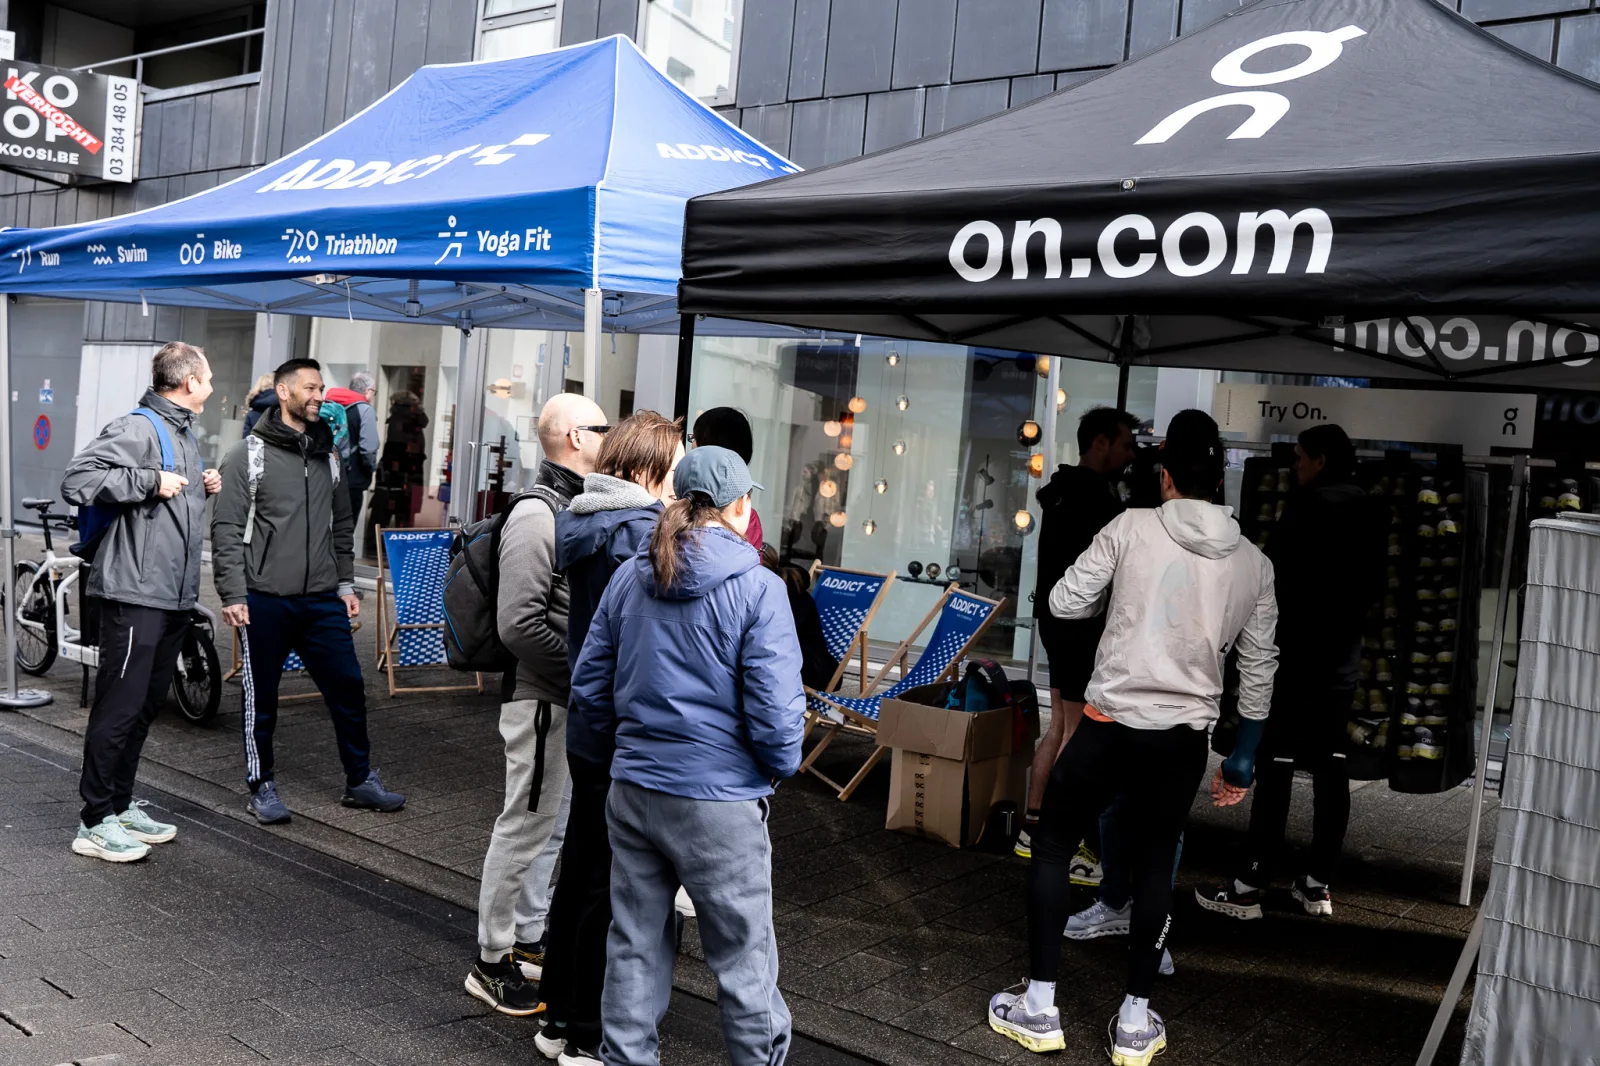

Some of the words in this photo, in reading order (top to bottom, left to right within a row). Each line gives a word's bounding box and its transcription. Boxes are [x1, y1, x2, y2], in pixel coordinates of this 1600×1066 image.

[114, 83, 128, 101] 05
[11, 79, 97, 147] VERKOCHT
[113, 105, 127, 122] 48
[111, 127, 126, 153] 284
[109, 158, 123, 175] 03
[656, 142, 774, 170] ADDICT
[256, 143, 482, 193] ADDICT
[117, 243, 148, 263] Swim
[213, 239, 242, 260] Bike
[325, 233, 398, 257] Triathlon
[476, 230, 521, 257] Yoga
[524, 227, 552, 252] Fit
[948, 207, 1334, 283] on.com
[40, 250, 60, 266] Run
[1258, 400, 1288, 423] Try
[1292, 402, 1327, 420] On.
[389, 533, 435, 541] ADDICT
[821, 576, 866, 593] ADDICT
[949, 596, 981, 616] ADDICT
[1155, 913, 1172, 950] SAYSKY
